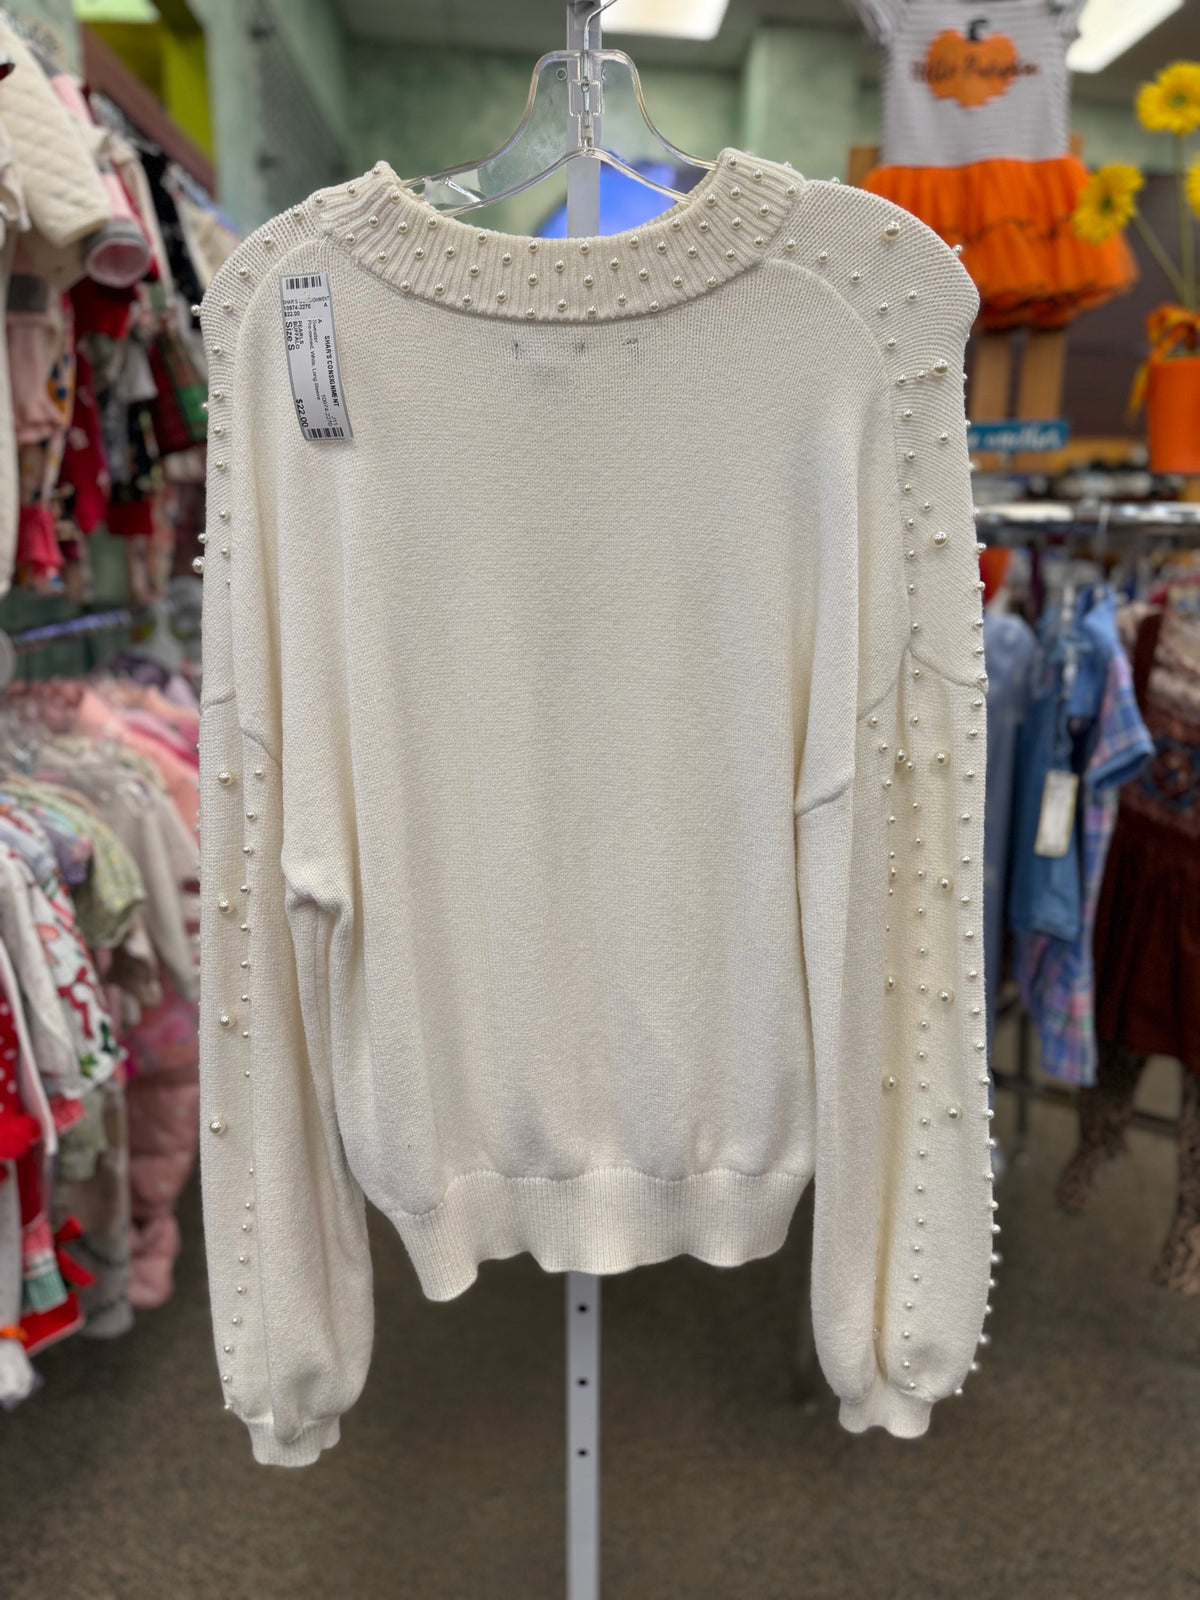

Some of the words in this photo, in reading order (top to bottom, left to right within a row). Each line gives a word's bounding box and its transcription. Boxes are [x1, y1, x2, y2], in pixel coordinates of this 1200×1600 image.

[285, 321, 293, 342] Size
[292, 321, 300, 349] BUFFALO
[327, 360, 340, 407] CONSIGNMENT
[295, 398, 309, 428] $22.00
